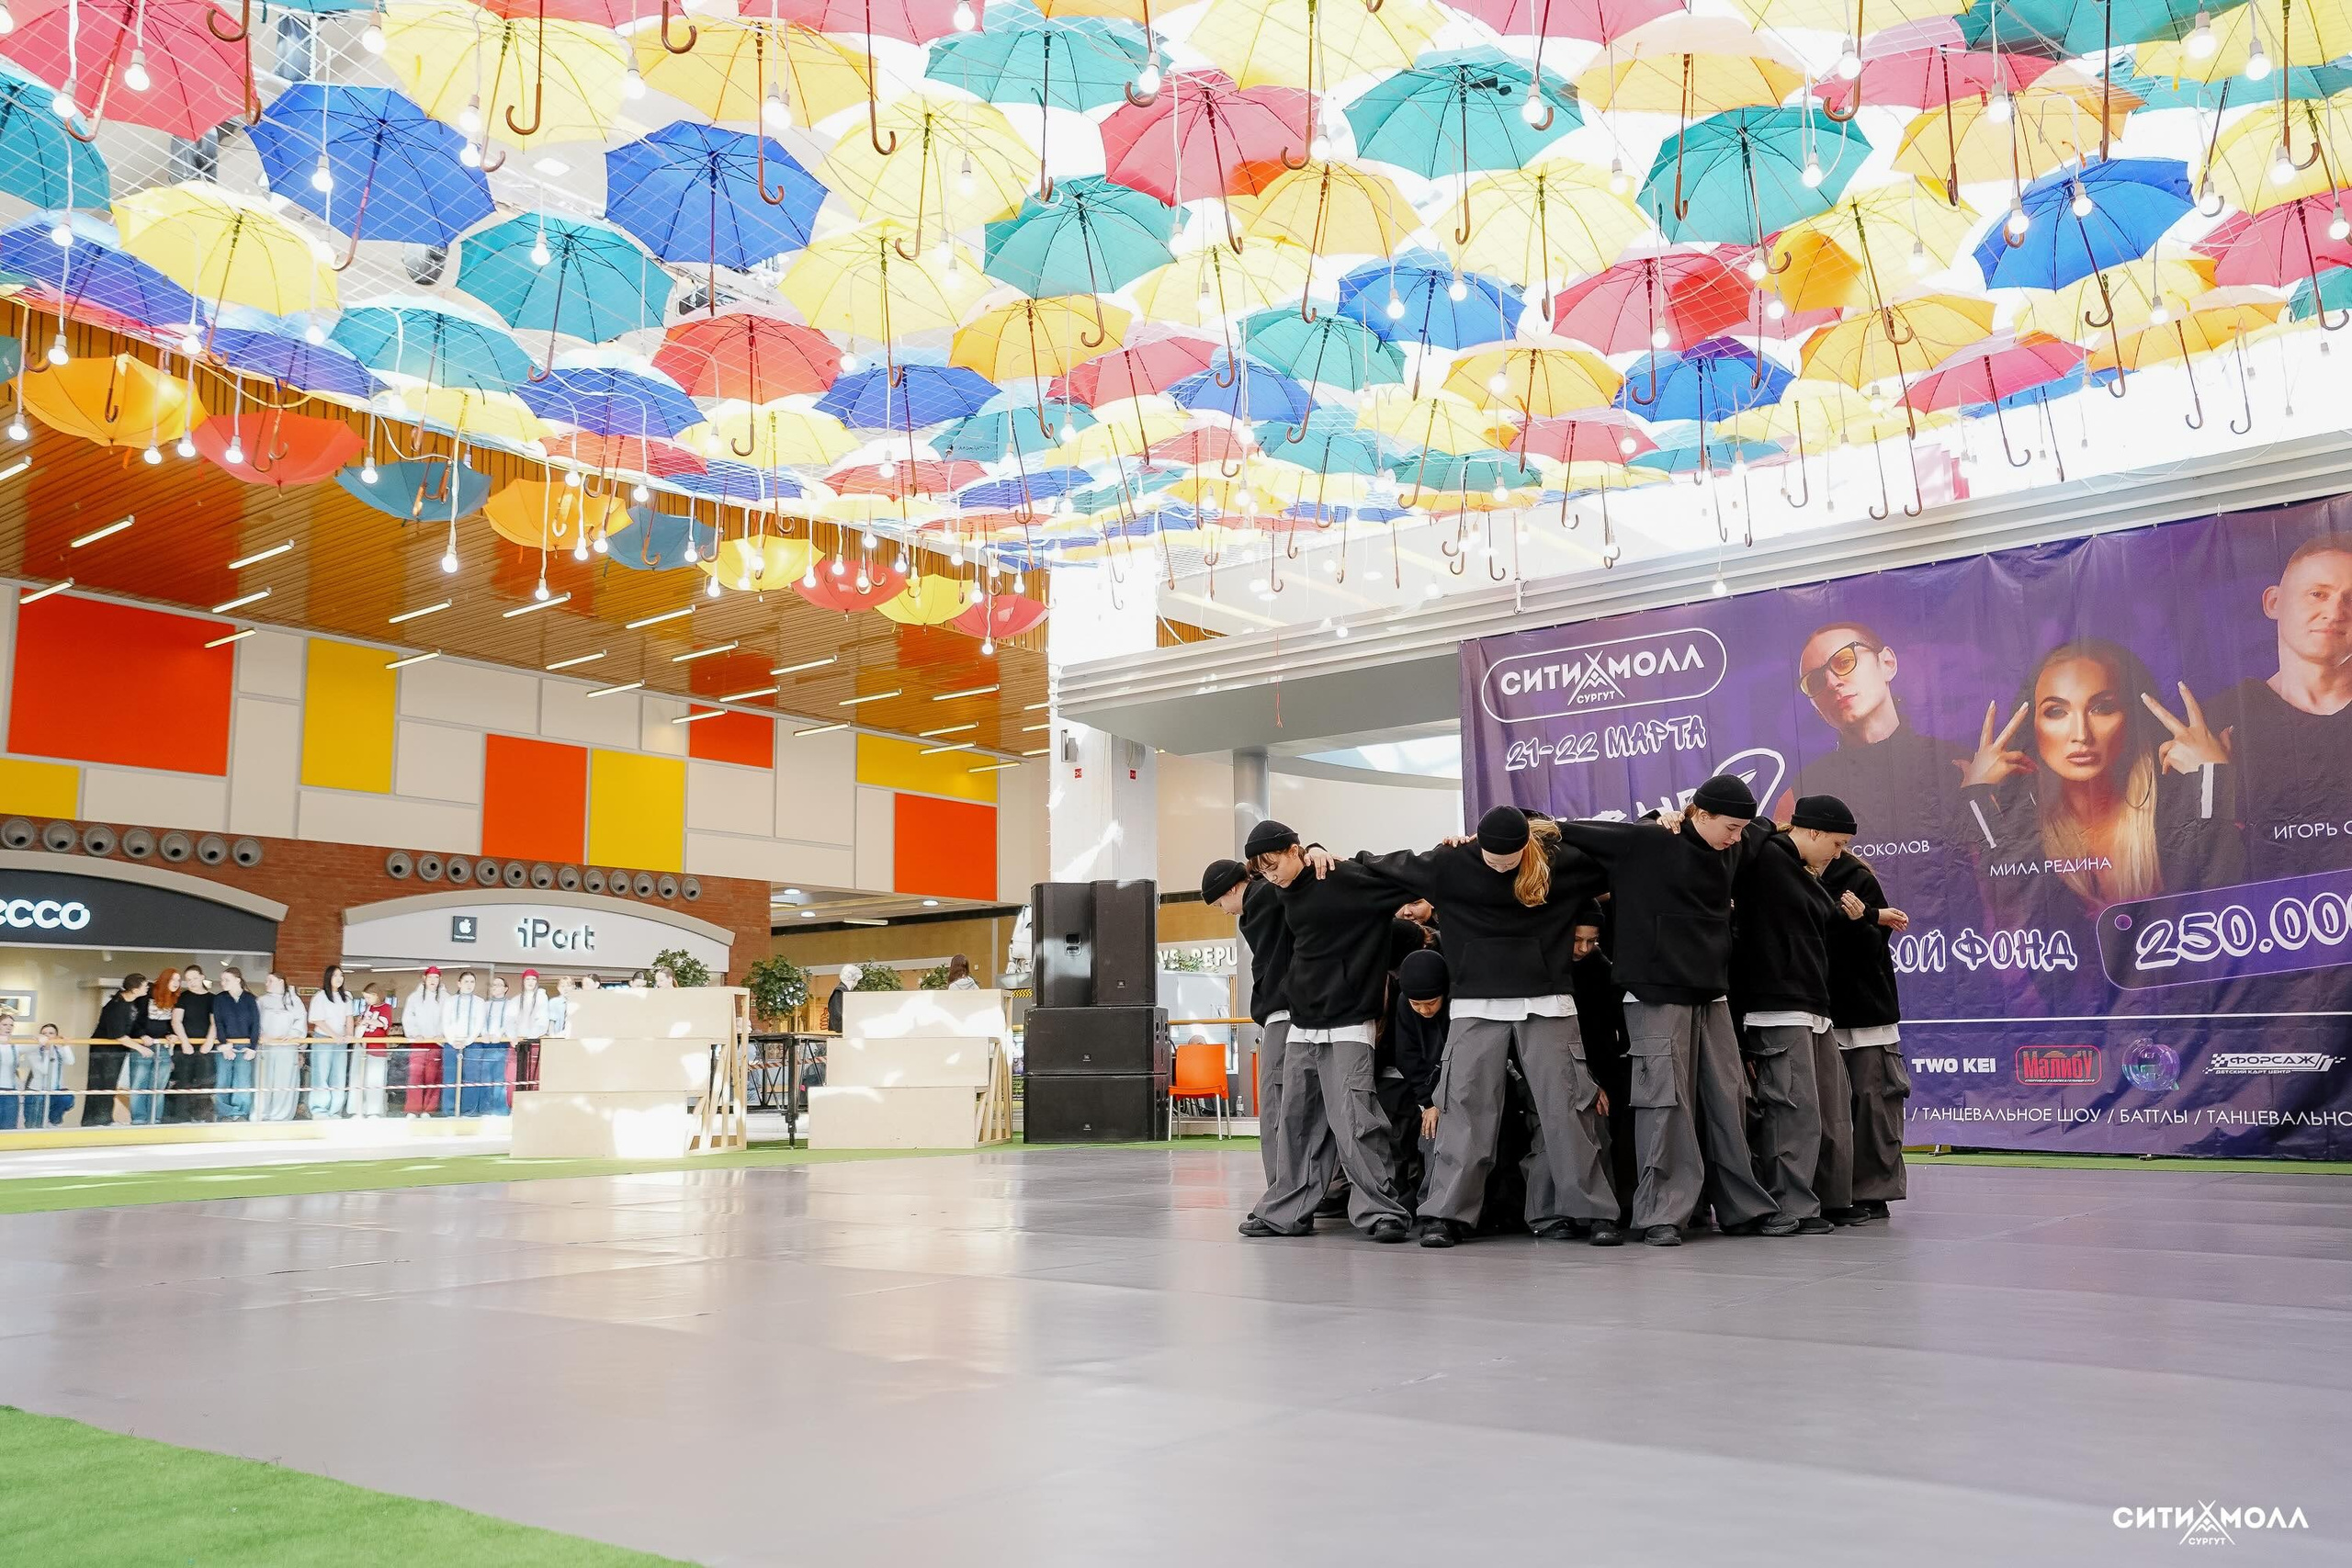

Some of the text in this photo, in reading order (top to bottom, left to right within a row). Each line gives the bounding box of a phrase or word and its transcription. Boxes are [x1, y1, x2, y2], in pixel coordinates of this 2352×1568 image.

[1500, 644, 1705, 696] СИТИ МОЛЛ
[1577, 690, 1615, 705] СУРГУТ
[1506, 715, 1707, 772] 21-22 МАРТА
[2274, 822, 2338, 840] ИГОРЬ
[1851, 840, 1930, 858] СОКОЛОВ
[1990, 856, 2112, 877] МИЛА РЕДИНА
[0, 899, 91, 931] cco
[517, 918, 595, 951] iPort
[2135, 892, 2352, 971] 250.00
[1951, 927, 2078, 972] ФОНД
[1911, 1057, 1996, 1073] TWO KEI
[2230, 1055, 2316, 1065] ФОРСАЖ
[1922, 1107, 2052, 1123] ТАНЦЕВАЛЬНОЕ
[2057, 1108, 2101, 1122] ШОУ
[2120, 1109, 2188, 1124] БАТТЛЫ
